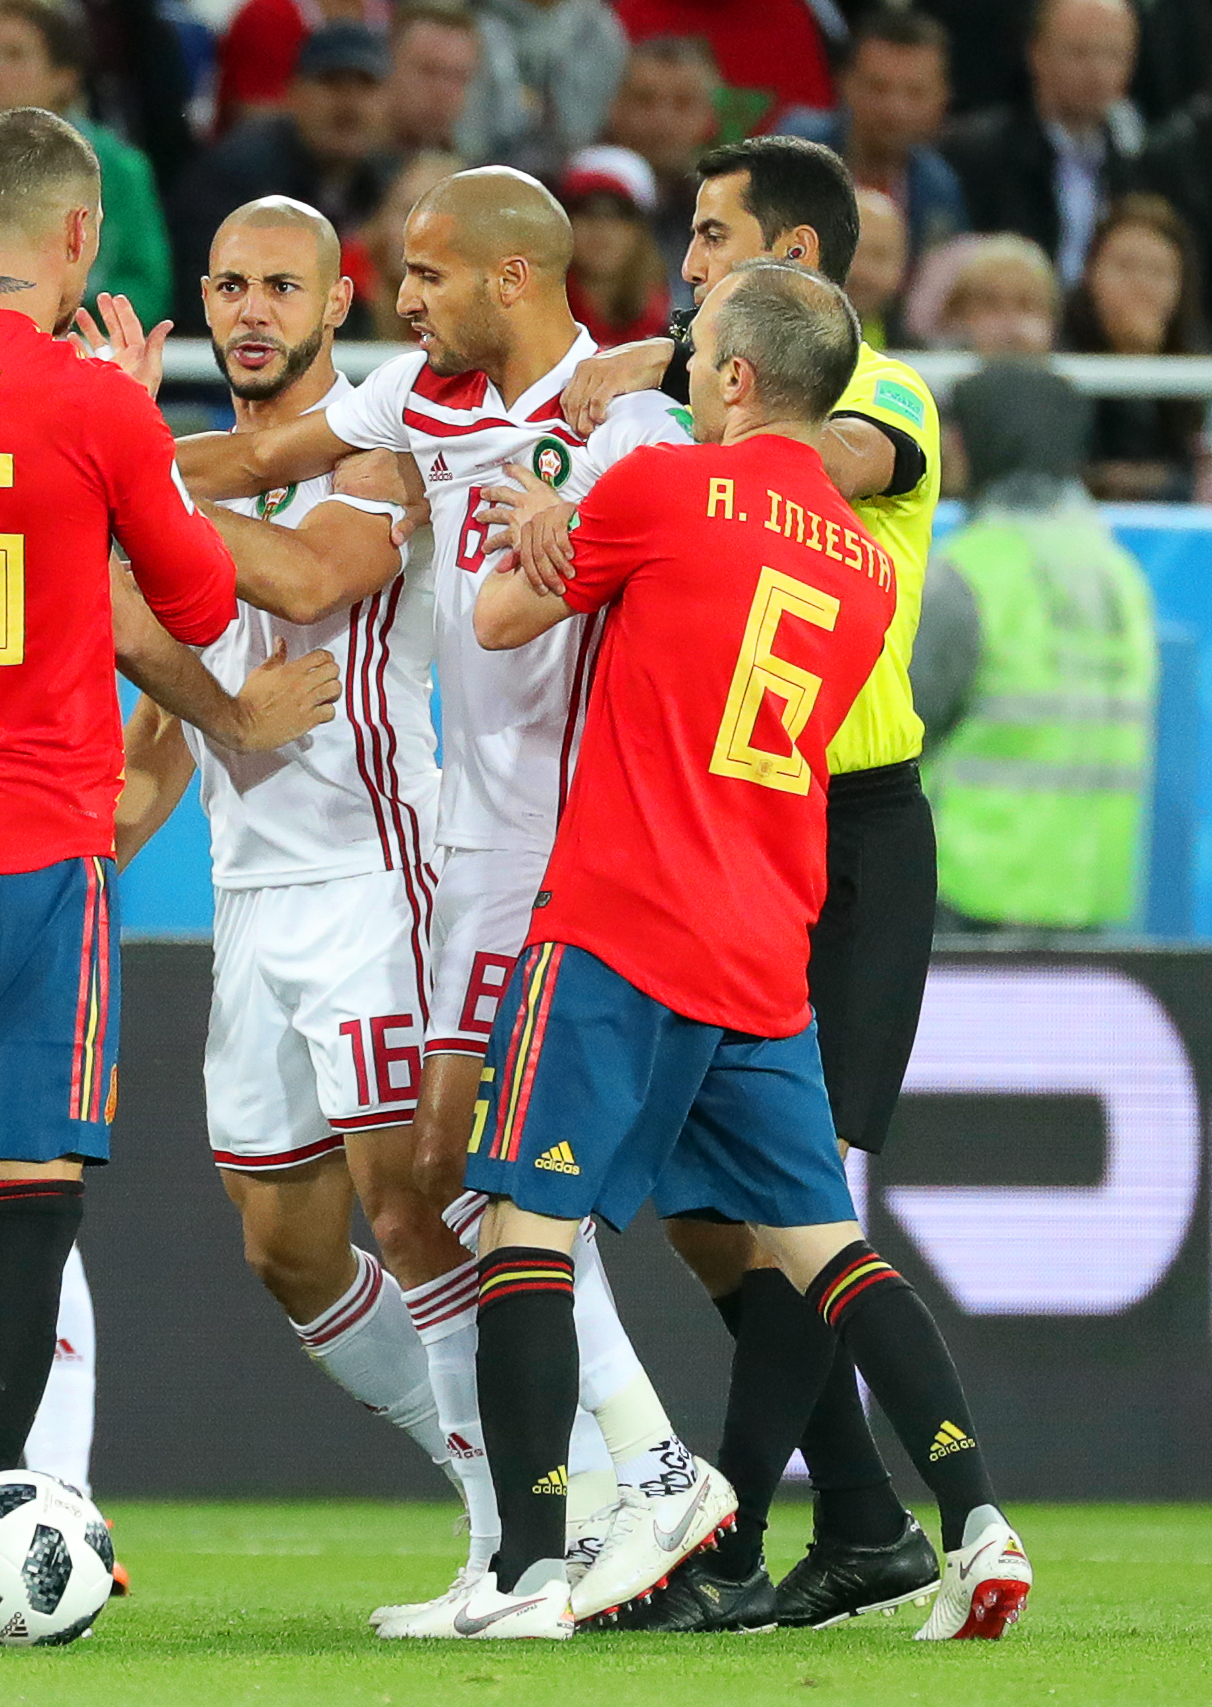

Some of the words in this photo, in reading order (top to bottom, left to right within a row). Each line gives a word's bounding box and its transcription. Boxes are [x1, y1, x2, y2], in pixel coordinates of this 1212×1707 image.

[706, 477, 748, 522] A.
[764, 489, 892, 593] INIESTA
[708, 565, 841, 796] 6
[457, 951, 520, 1035] 8
[339, 1013, 423, 1106] 16
[534, 1158, 581, 1176] adidas
[929, 1438, 976, 1462] adidas
